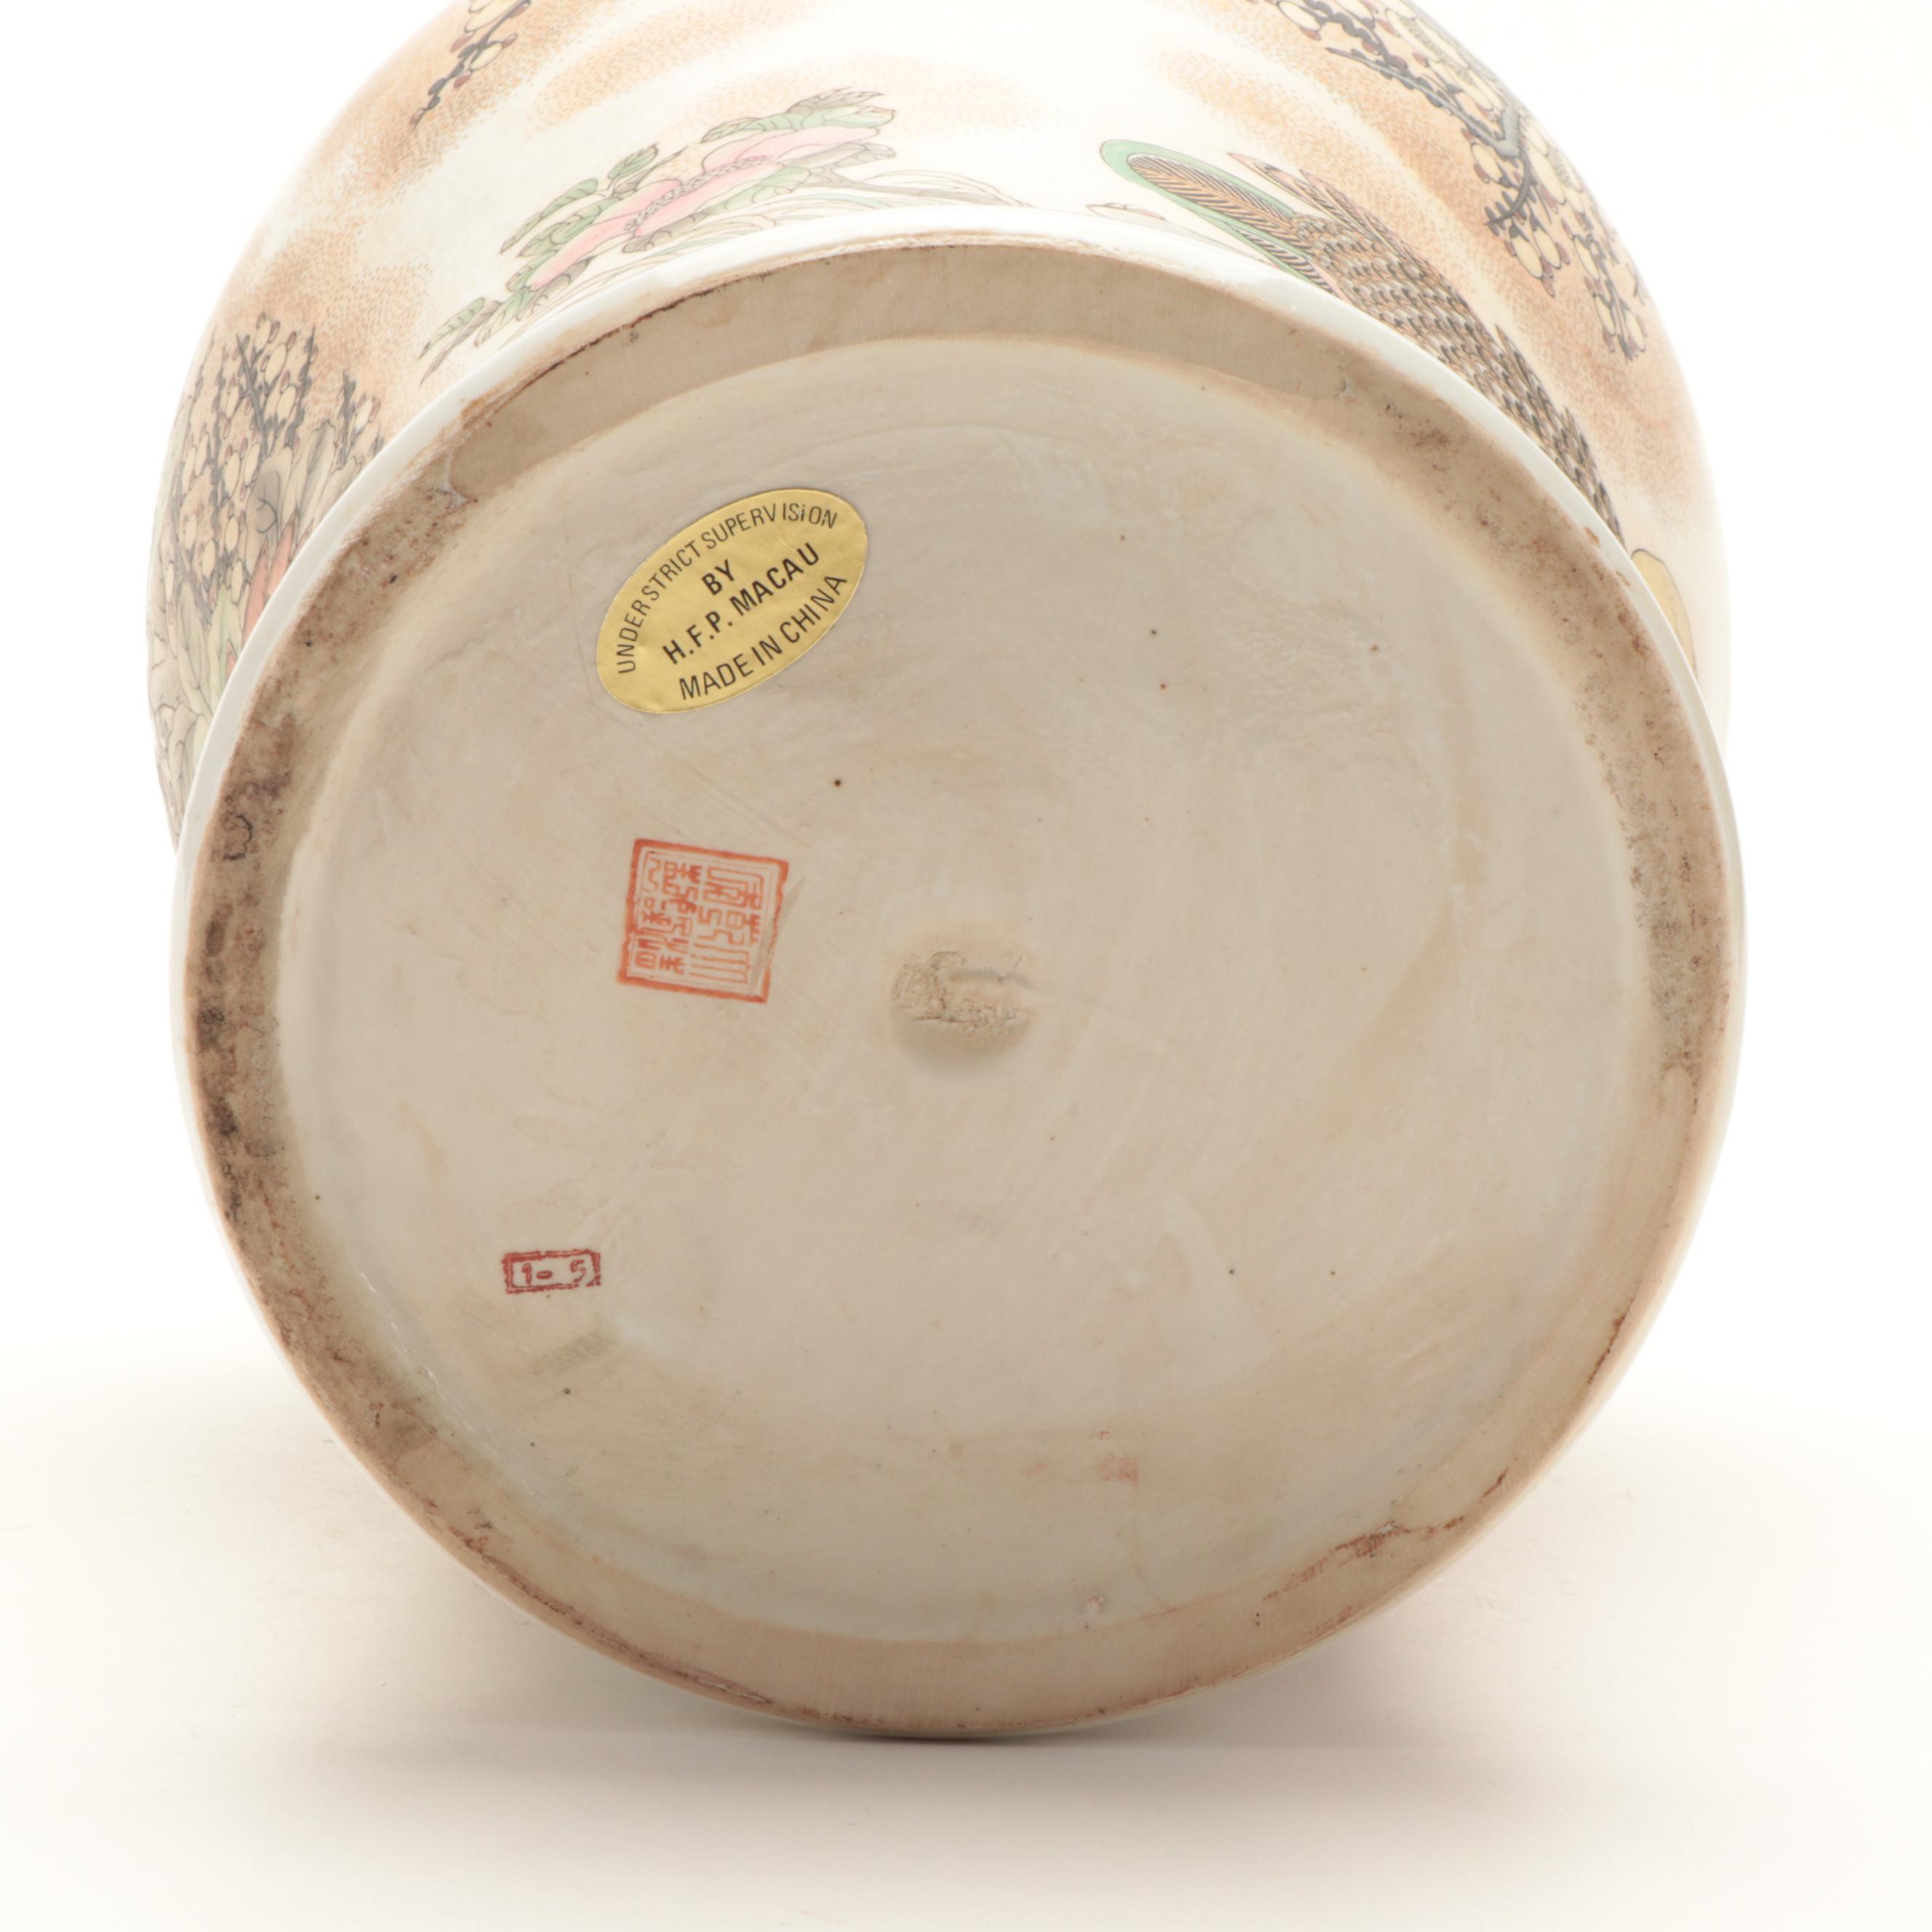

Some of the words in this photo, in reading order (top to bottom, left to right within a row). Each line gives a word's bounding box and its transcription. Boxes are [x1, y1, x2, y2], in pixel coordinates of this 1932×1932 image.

[615, 599, 651, 674] UNDER
[641, 540, 701, 601] STRICT
[661, 610, 733, 665] H.F.P.
[728, 542, 820, 617] MACAU
[679, 653, 754, 700] MADE
[751, 634, 783, 666] IN
[779, 575, 848, 644] CHINA
[700, 558, 735, 596] BY
